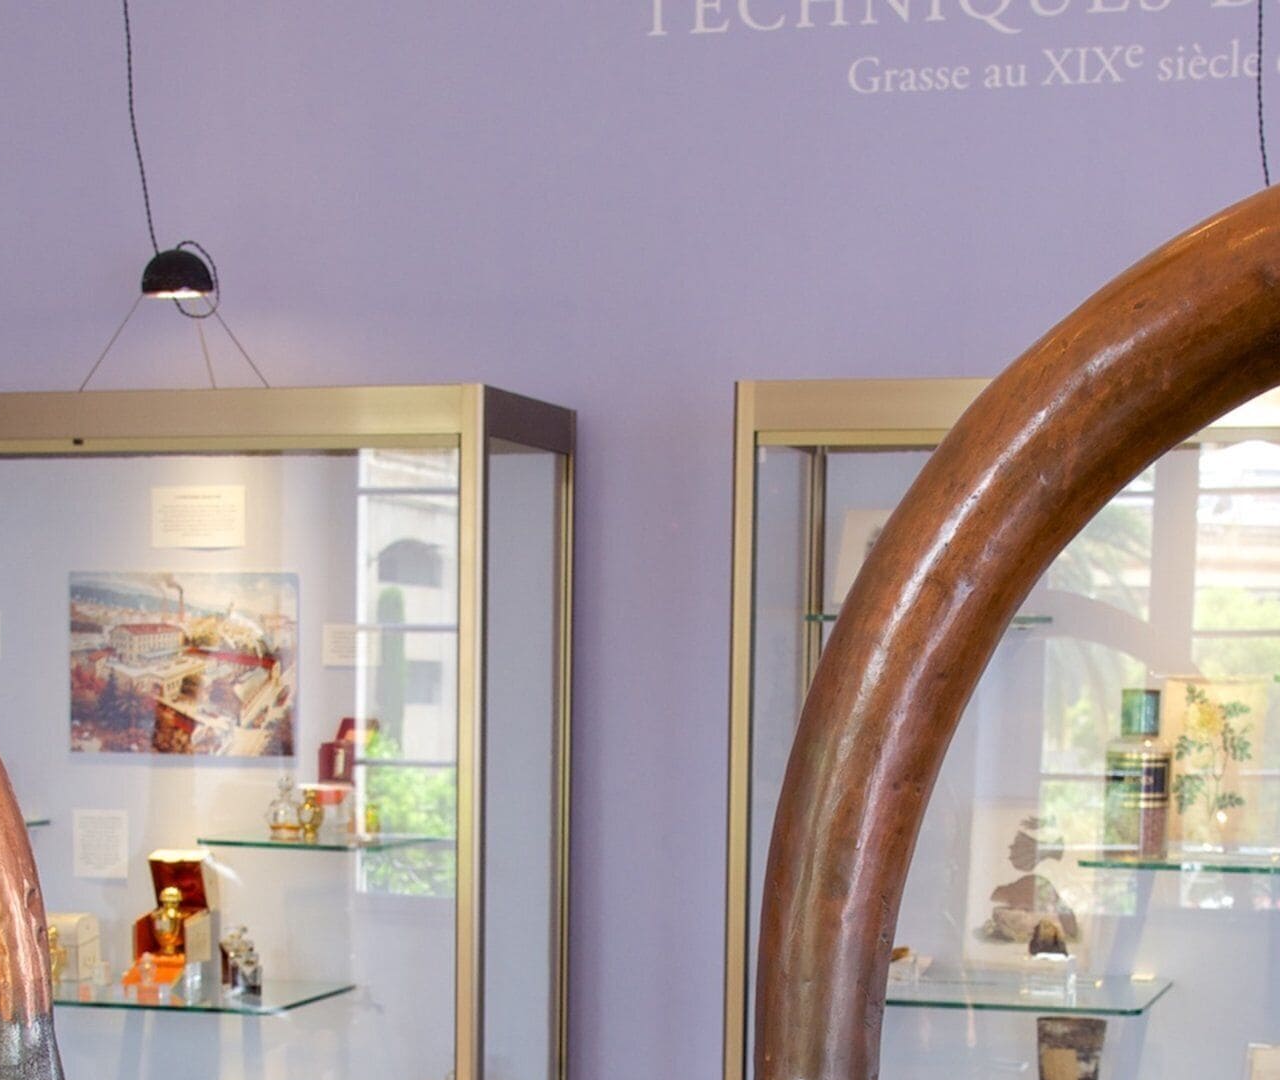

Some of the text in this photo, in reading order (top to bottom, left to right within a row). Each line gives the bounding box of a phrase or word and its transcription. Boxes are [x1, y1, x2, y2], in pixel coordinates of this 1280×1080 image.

[646, 0, 1168, 36] TECHNQ
[847, 56, 970, 94] Grasse
[983, 63, 1028, 88] au
[1157, 39, 1260, 81] siècle
